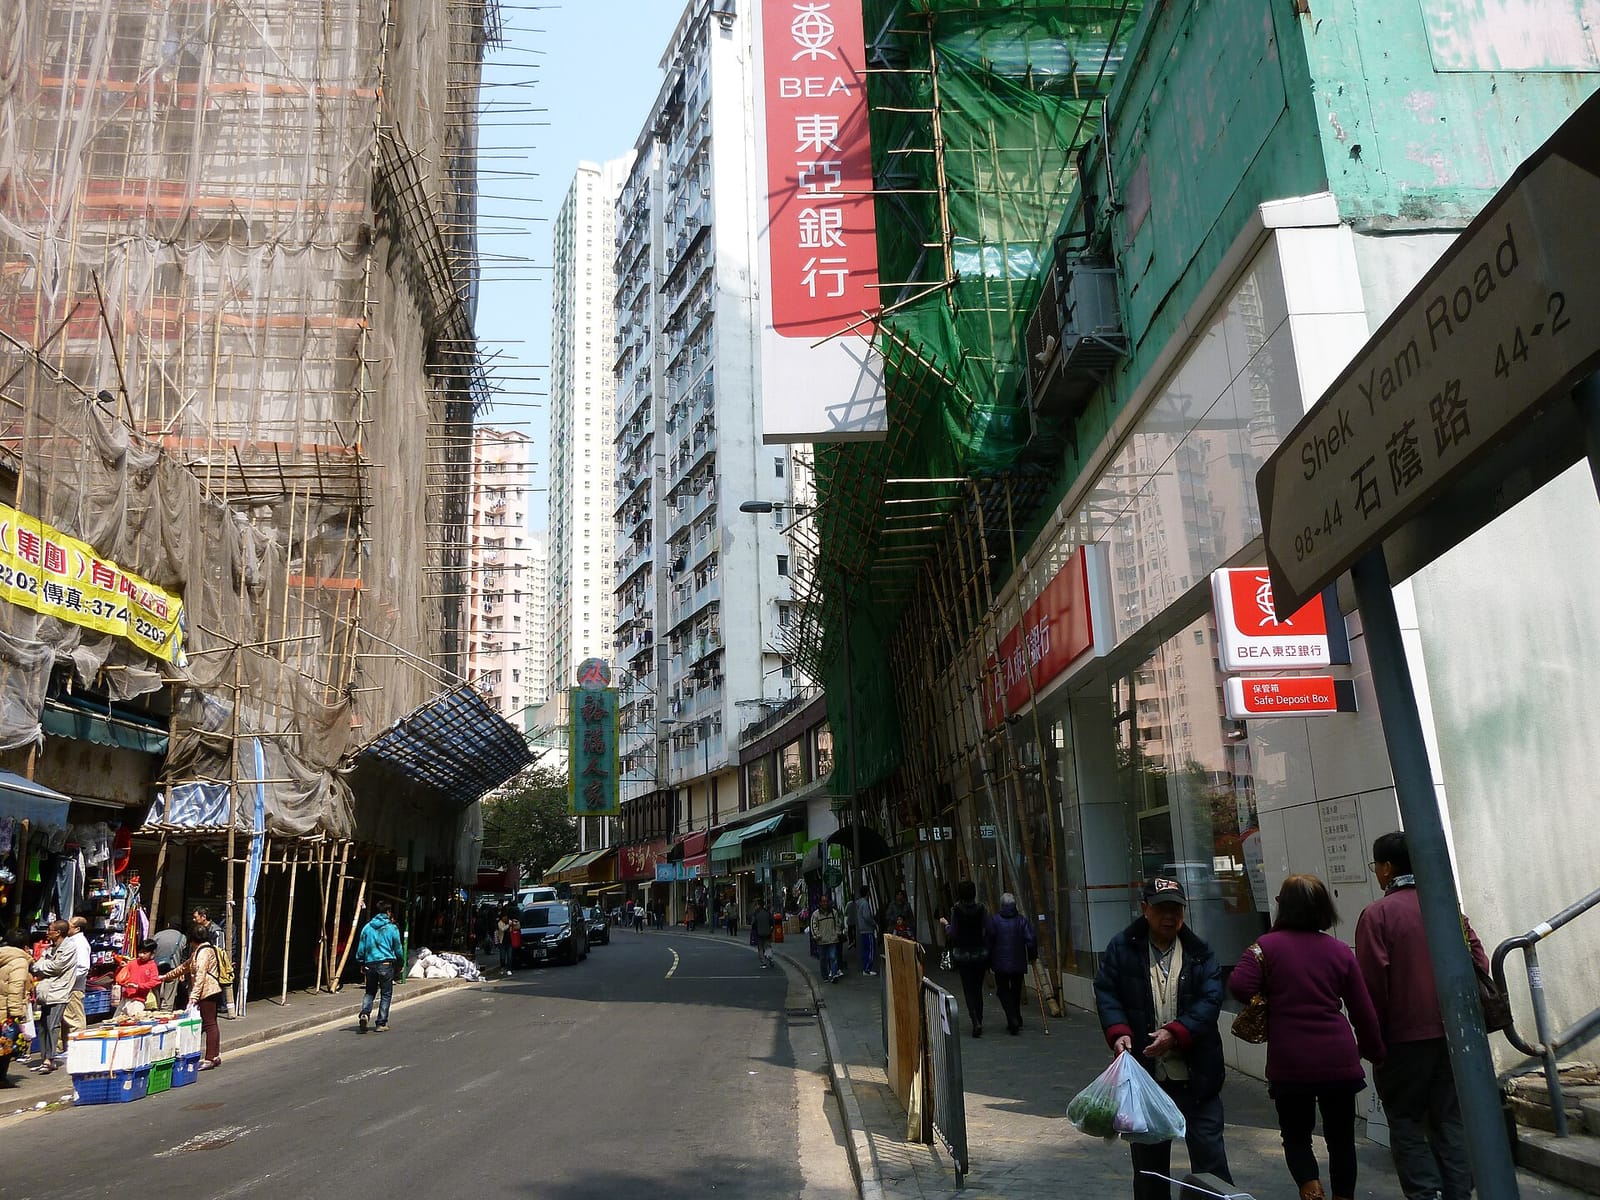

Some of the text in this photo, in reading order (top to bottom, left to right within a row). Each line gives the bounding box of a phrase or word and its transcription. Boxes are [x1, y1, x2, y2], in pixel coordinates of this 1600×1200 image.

[779, 76, 852, 99] BEA
[794, 113, 849, 298] 東亞銀行
[1301, 223, 1519, 481] Shek Yam Road
[1350, 378, 1471, 521] 石蔭路
[1238, 645, 1322, 658] BEA 東亞銀行
[1252, 684, 1279, 694] 保管箱
[1254, 694, 1329, 706] Safe Deposit Box
